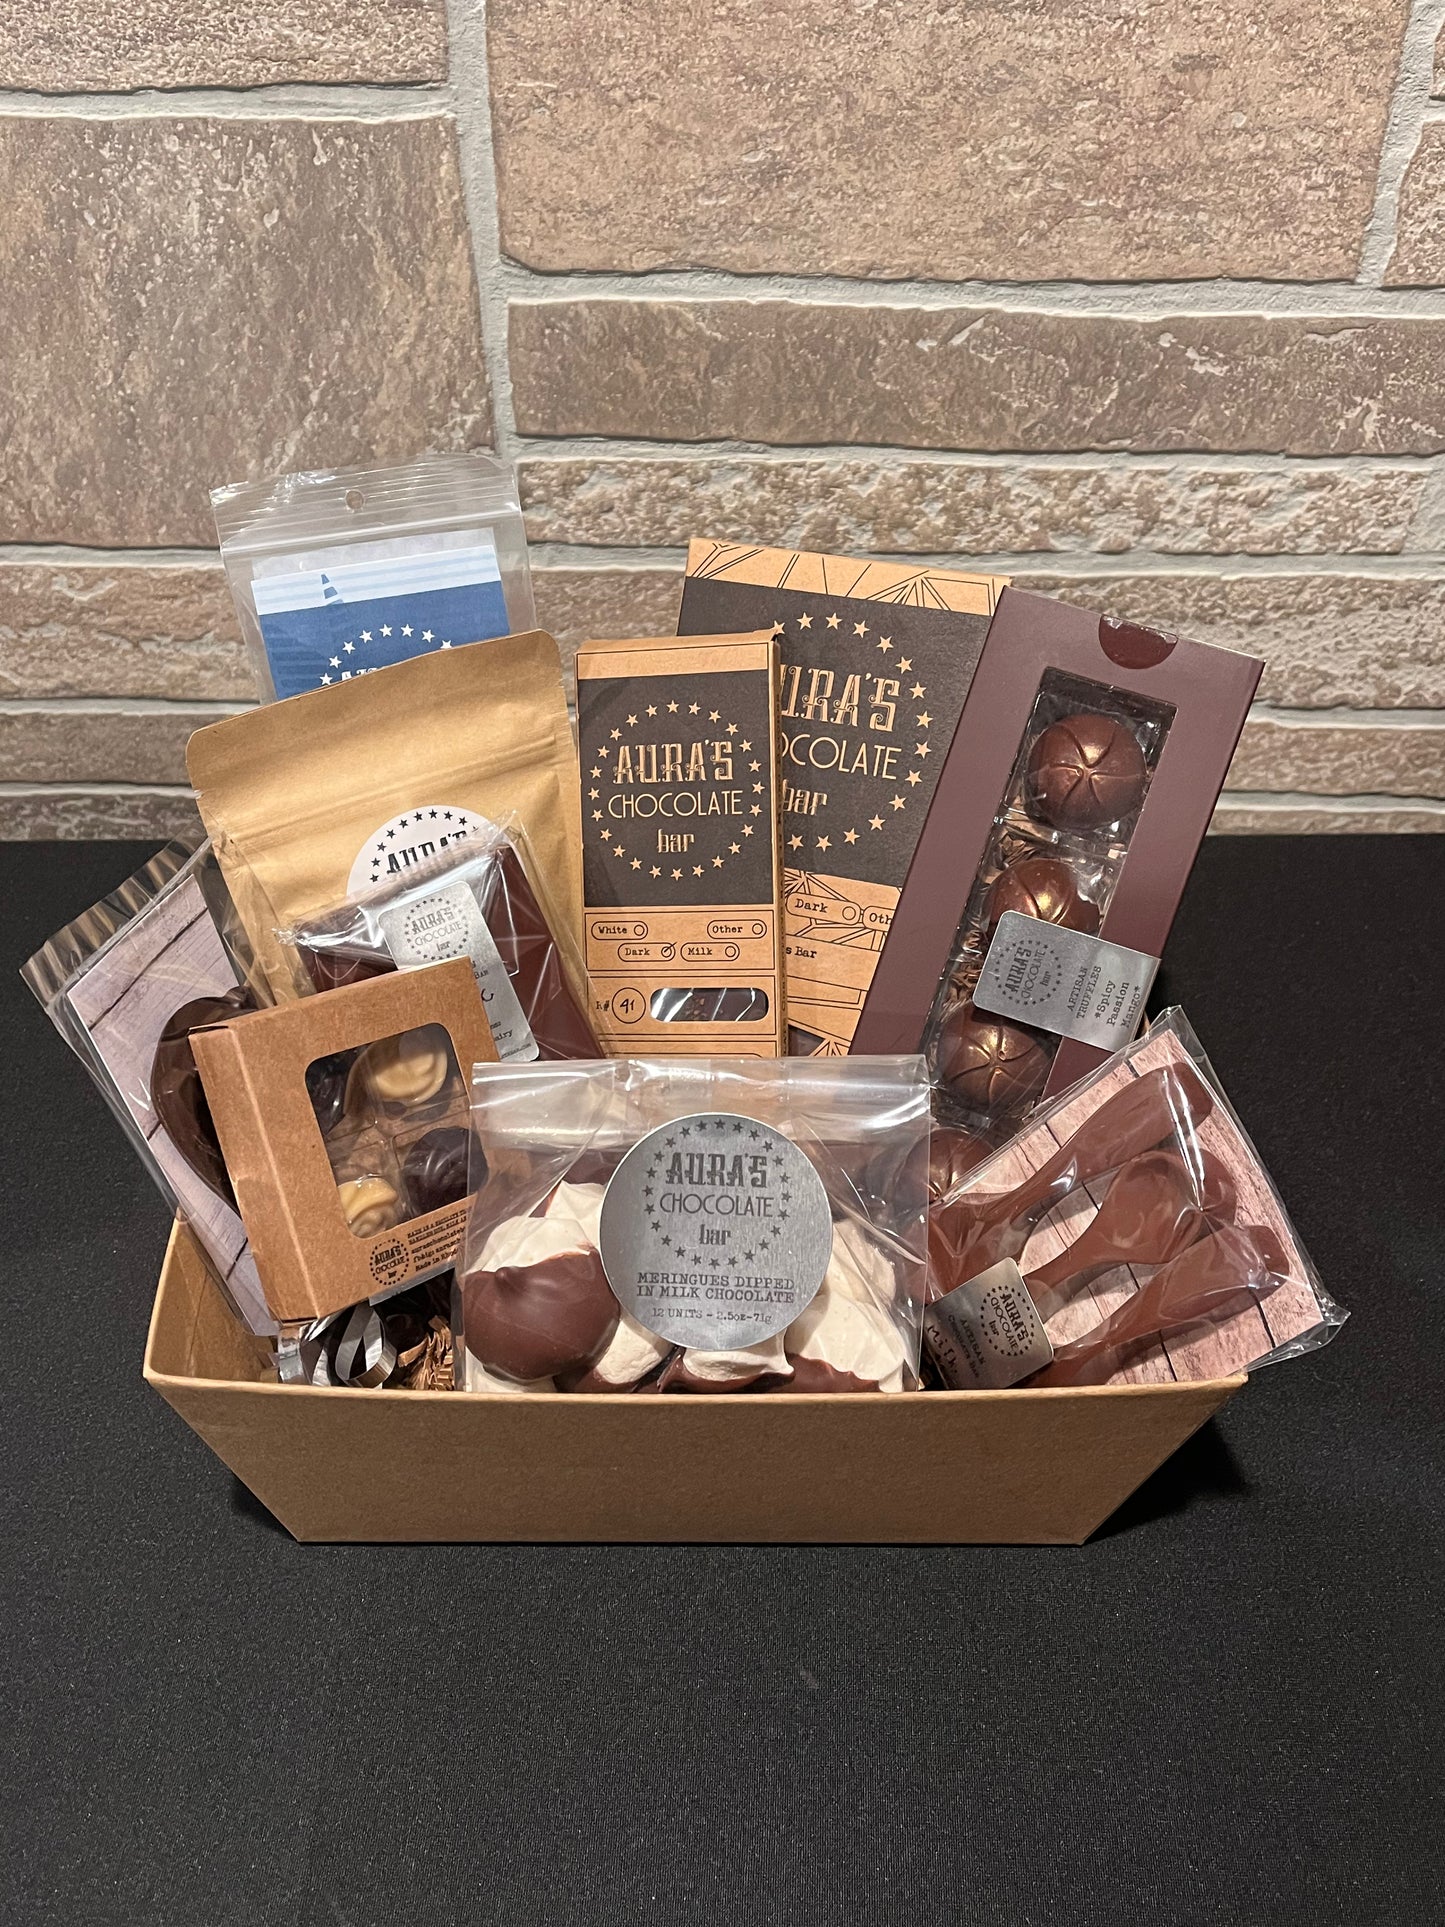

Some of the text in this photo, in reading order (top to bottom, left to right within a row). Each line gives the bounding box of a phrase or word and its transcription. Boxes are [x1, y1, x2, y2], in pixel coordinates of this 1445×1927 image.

[781, 664, 901, 733] URA'S
[613, 739, 733, 784] AURA'S
[781, 732, 902, 780] COLATE
[608, 790, 743, 819] CHOCOLATE
[657, 828, 695, 853] bar
[411, 905, 455, 936] AURA'S
[795, 898, 893, 925] Dark Oth
[415, 920, 463, 947] CHOCOLATE
[598, 924, 744, 935] White Other
[625, 947, 713, 956] Dark Milk
[794, 945, 818, 959] Bar
[1004, 946, 1032, 994] AURA'S
[1021, 949, 1046, 999] CHOCOLATE
[1066, 966, 1088, 1012] ARTISAN
[1076, 965, 1102, 1019] TRUFFLES
[1106, 981, 1130, 1027] Passion
[665, 1152, 768, 1188] AURA'S
[659, 1192, 775, 1218] CHOCOLATE
[698, 1223, 732, 1246] bar
[637, 1272, 795, 1290] MERINGUES DIPPED
[637, 1285, 795, 1304] IN MILK CHOCOLATE
[652, 1307, 665, 1318] 12
[668, 1308, 703, 1320] UNITS
[990, 1296, 1020, 1350] CHOCOLATE
[1000, 1292, 1030, 1342] AURA'S
